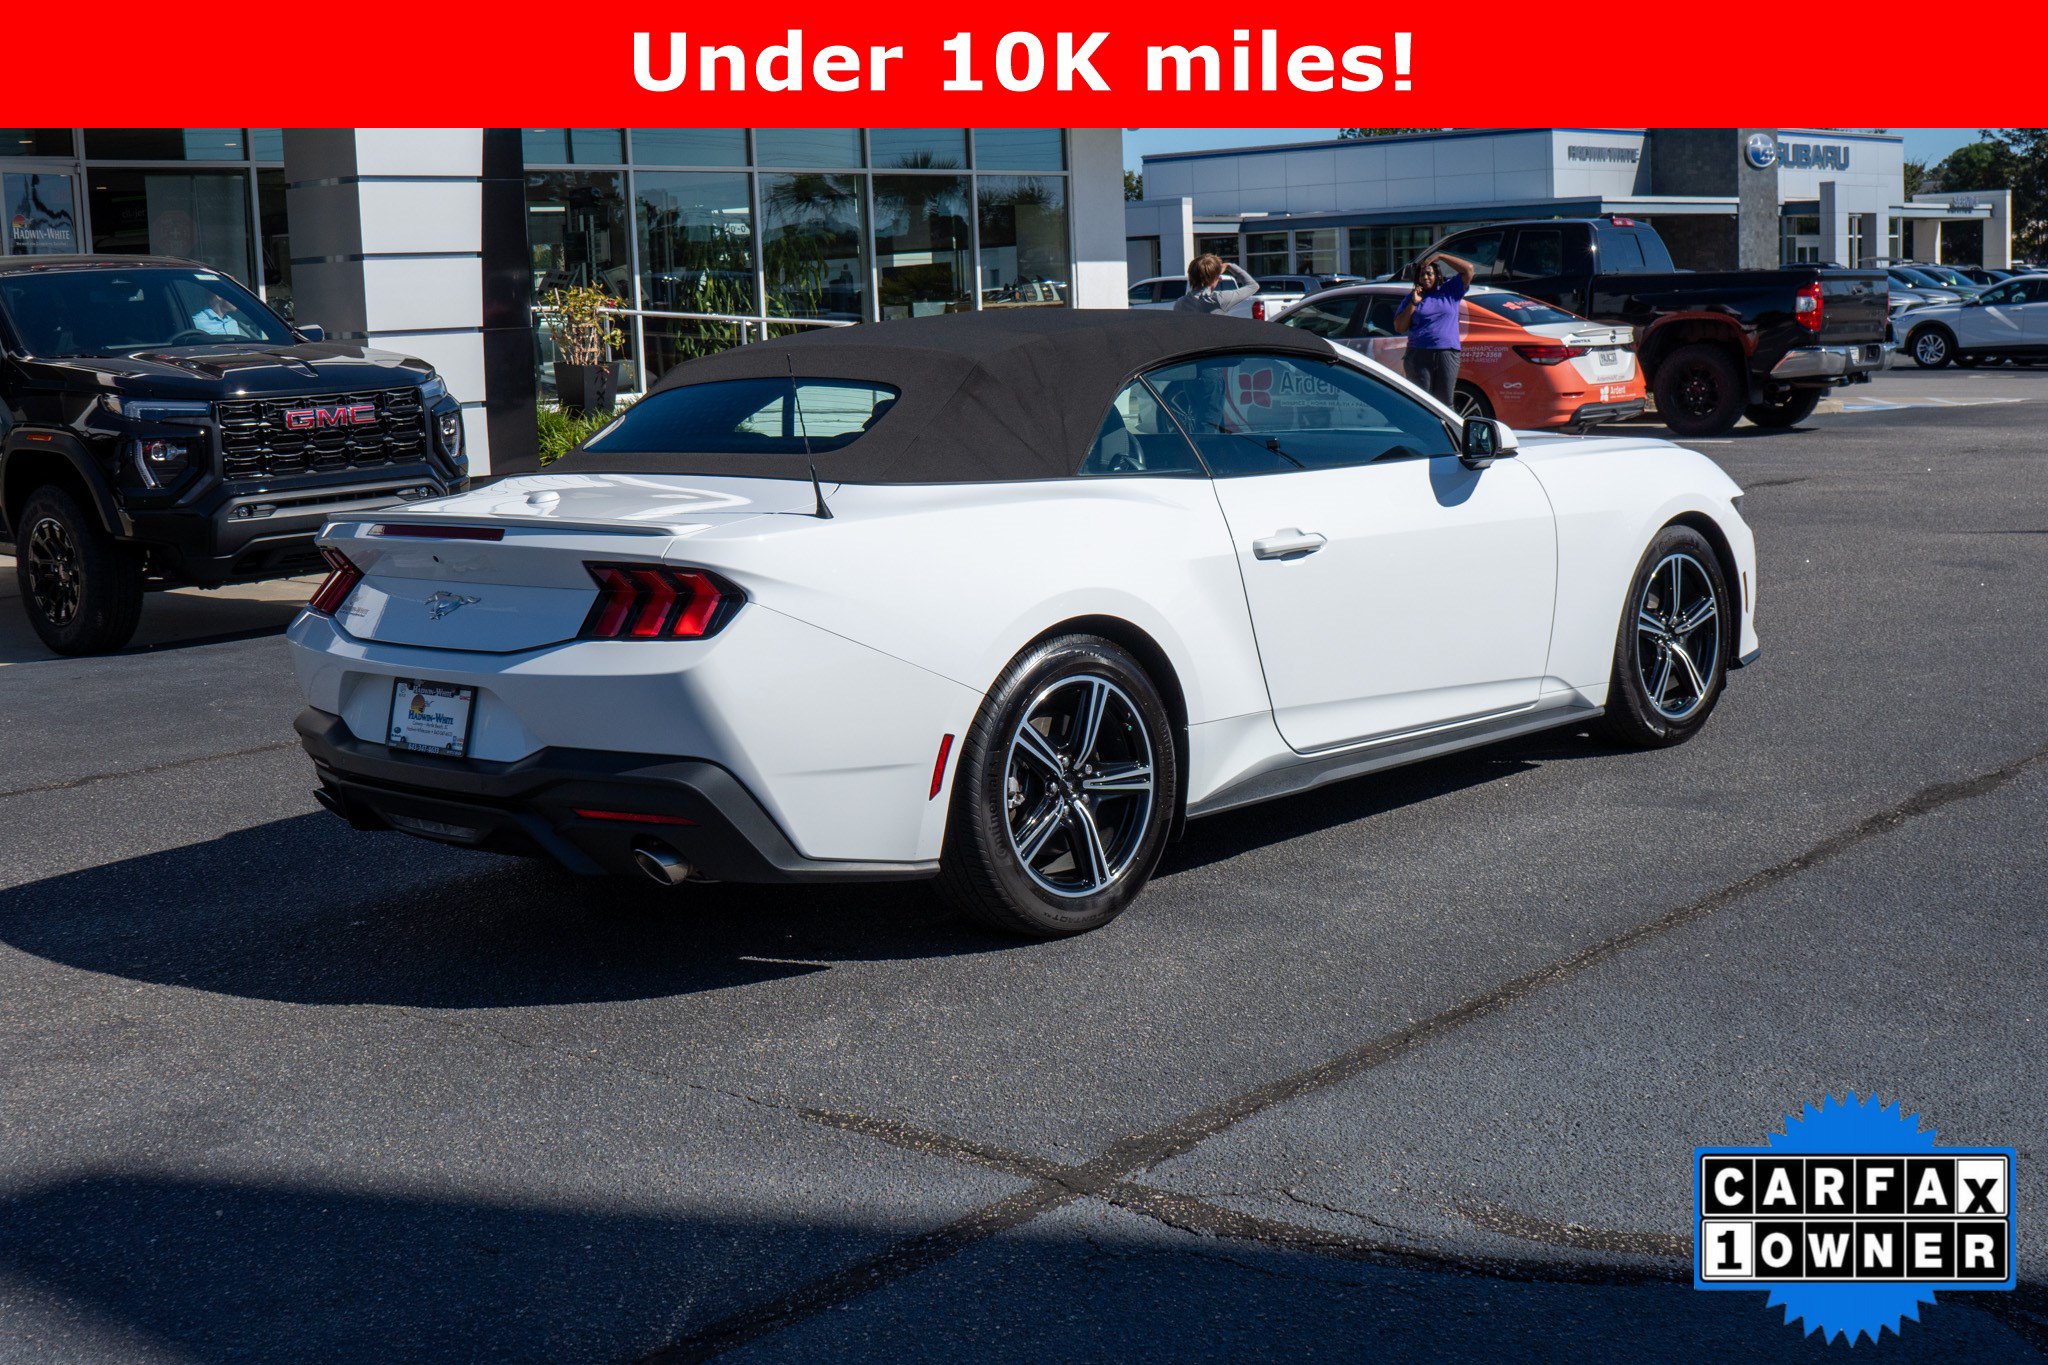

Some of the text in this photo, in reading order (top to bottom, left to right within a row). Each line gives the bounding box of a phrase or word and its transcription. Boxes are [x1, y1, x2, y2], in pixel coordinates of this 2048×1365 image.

[1777, 142, 1850, 170] SUBARU
[286, 403, 377, 430] GMC
[408, 709, 454, 724] HADWIN-WHITE
